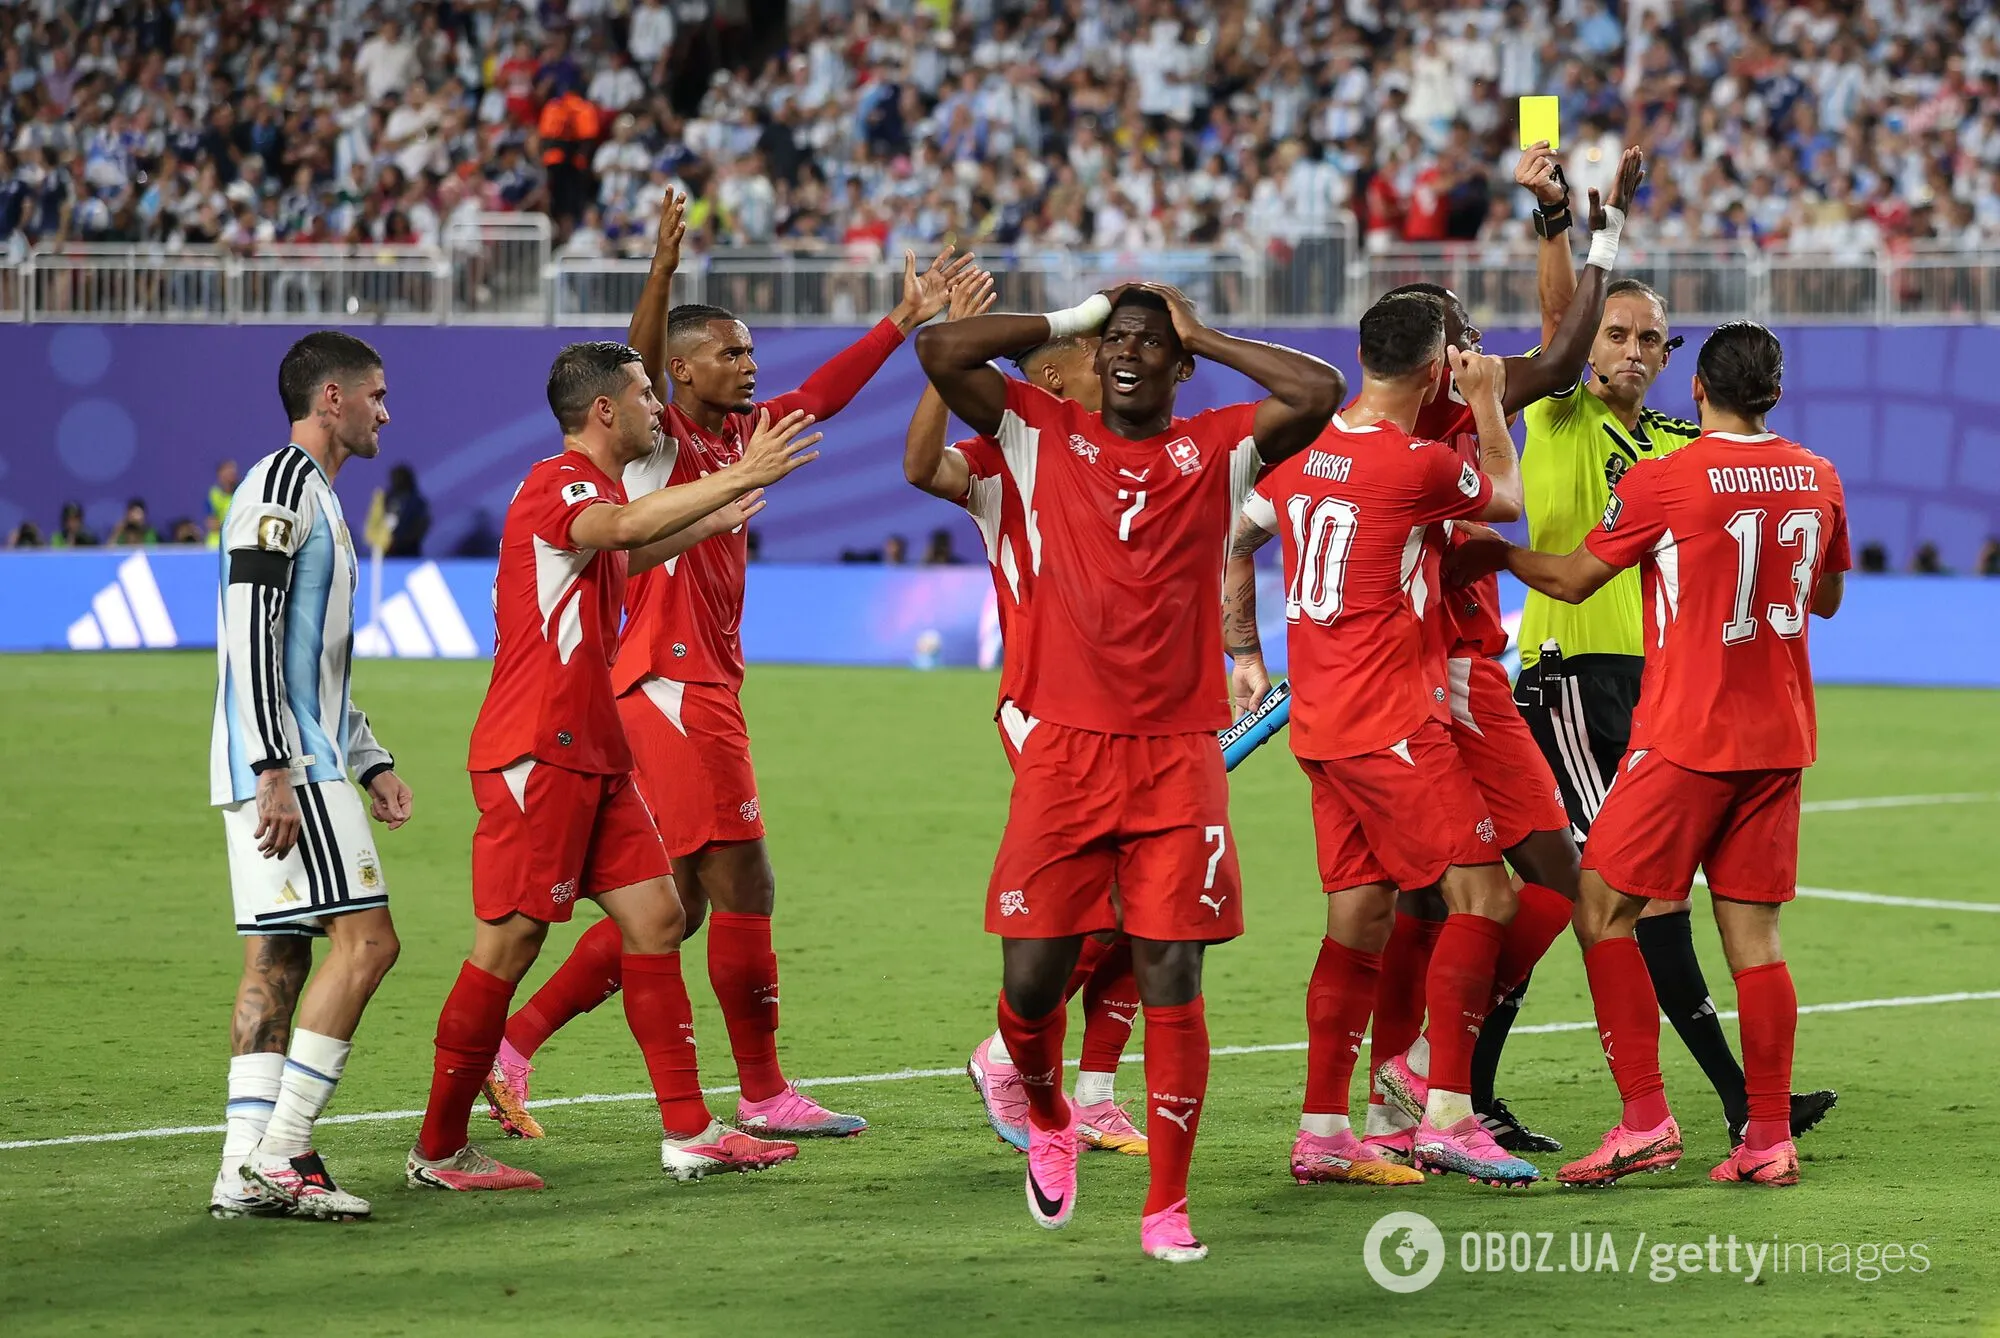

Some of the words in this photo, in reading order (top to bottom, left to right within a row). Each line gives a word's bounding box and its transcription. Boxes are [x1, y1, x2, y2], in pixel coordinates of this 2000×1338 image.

[1303, 449, 1353, 483] XHAKA
[1707, 465, 1819, 494] RODRIGUEZ
[1117, 487, 1147, 542] 7
[1286, 493, 1361, 627] 10
[1722, 508, 1823, 647] 13
[1203, 825, 1226, 889] 7
[1152, 1092, 1198, 1105] suisse
